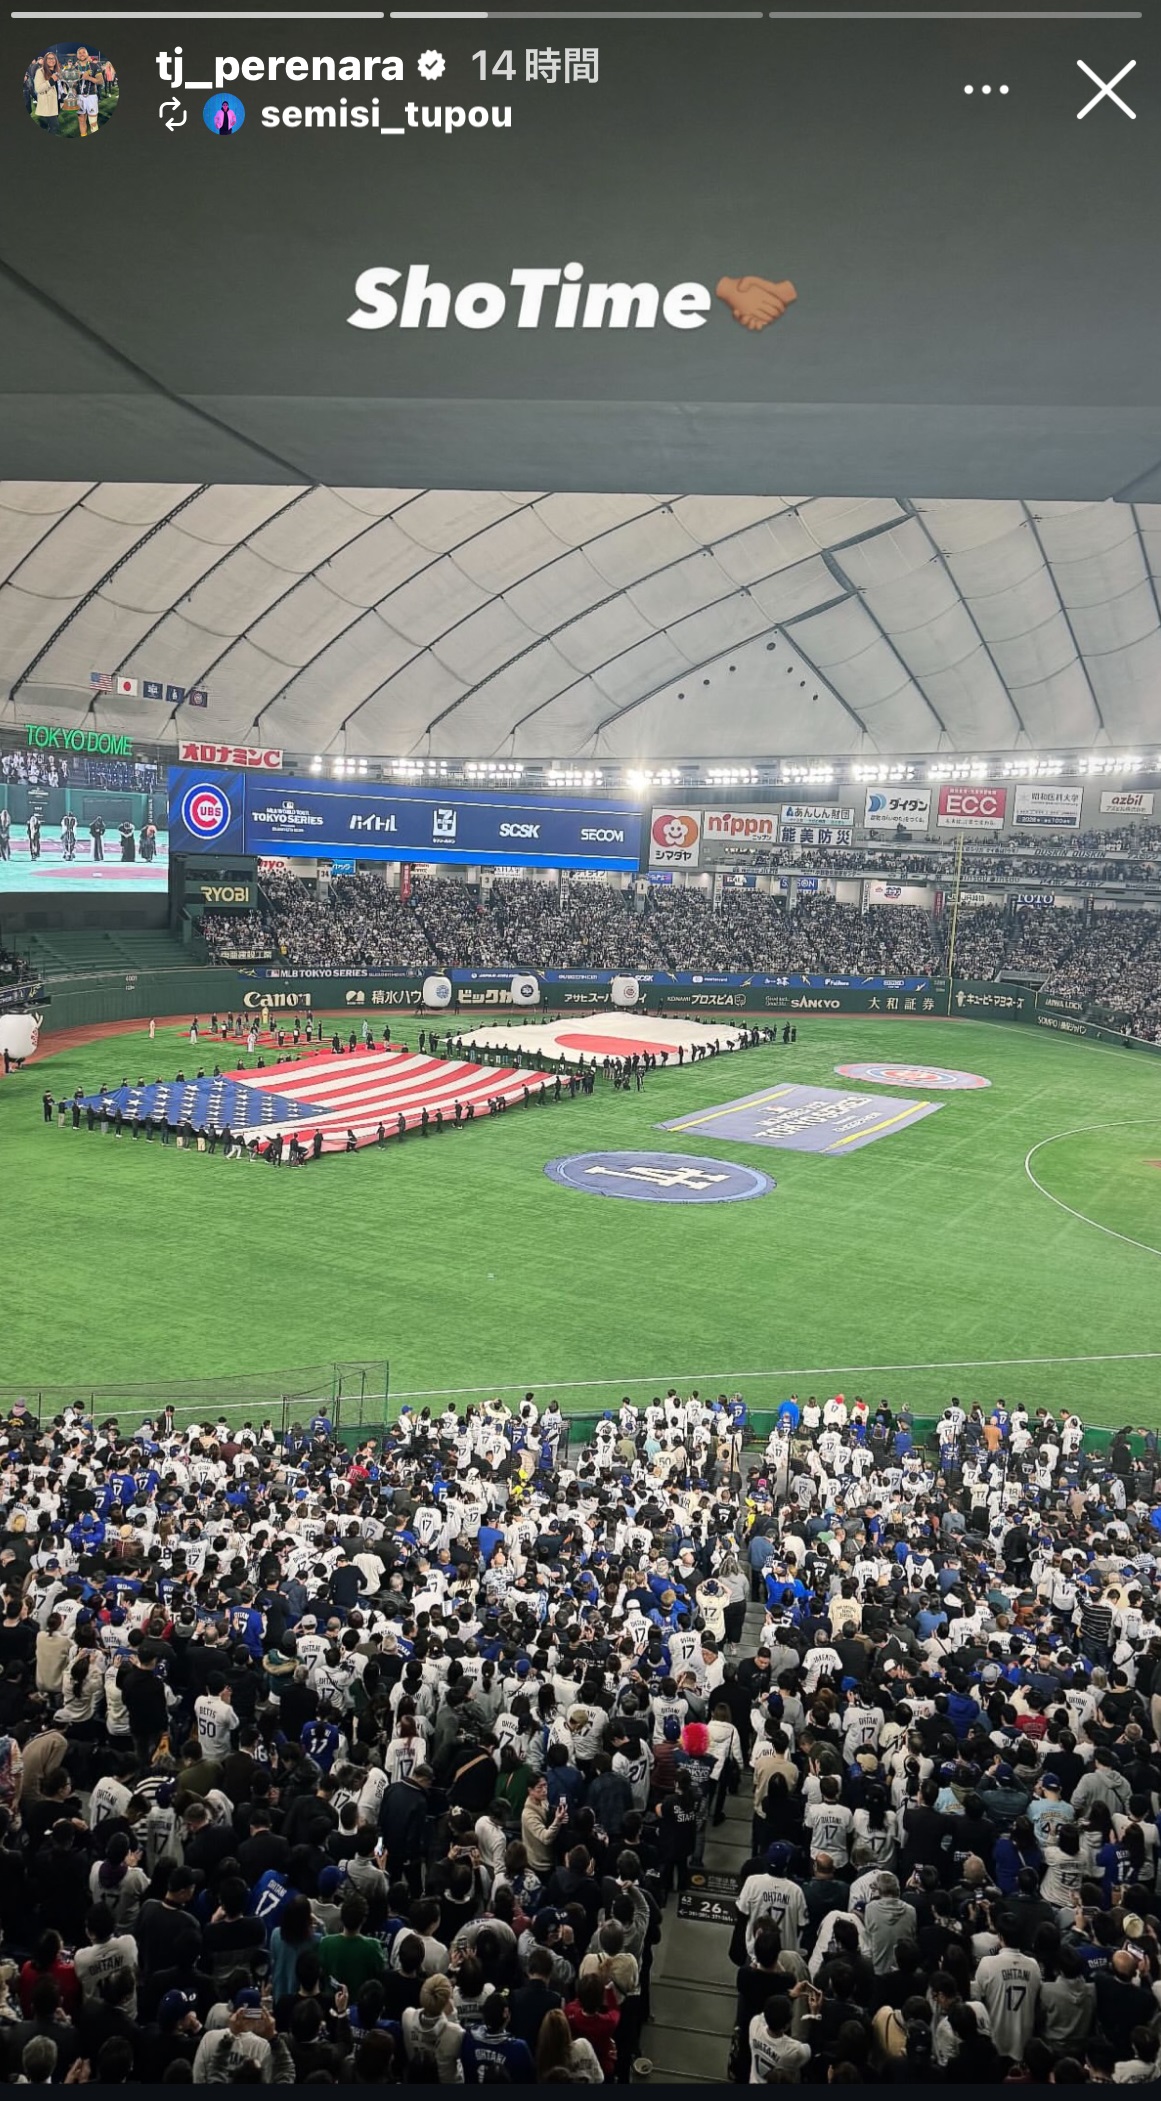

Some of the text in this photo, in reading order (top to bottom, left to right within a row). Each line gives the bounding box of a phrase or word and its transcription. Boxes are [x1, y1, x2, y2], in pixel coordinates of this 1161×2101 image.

[26, 724, 133, 756] TOKYO DOME
[182, 743, 281, 768] オロナミンC
[946, 795, 997, 815] ECC
[1111, 794, 1143, 806] azbil
[252, 812, 324, 825] TOKYO SERIES
[794, 807, 850, 820] あんしん財団
[350, 814, 397, 832] バイトル
[708, 814, 773, 836] nippn
[499, 823, 541, 839] SCSK
[580, 828, 625, 843] SECOM
[782, 827, 850, 844] 能美防災
[655, 850, 692, 861] シマダヤ
[201, 886, 249, 902] RYOBI
[1018, 894, 1054, 904] TOTO
[280, 970, 298, 978] MLB
[334, 969, 368, 978] SERIES
[243, 991, 312, 1009] Canon
[372, 990, 424, 1005] 積水ハウ
[791, 995, 840, 1009] SANKYO
[868, 998, 934, 1011] 大和証券
[585, 1165, 731, 1190] LA
[422, 1519, 430, 1531] 17
[188, 1554, 200, 1565] 17
[34, 1594, 46, 1609] 17
[704, 1608, 716, 1616] 17
[634, 1629, 644, 1642] 17
[682, 1645, 694, 1658] 17
[304, 1654, 316, 1670] 17
[322, 1688, 335, 1698] 17
[199, 1718, 216, 1738] 50
[861, 1727, 874, 1742] 17
[312, 1738, 329, 1752] 17
[332, 1792, 350, 1807] 17
[821, 1816, 842, 1824] OHTANI
[825, 1826, 837, 1839] 17
[154, 1833, 168, 1855] 17
[268, 1879, 287, 1897] OHTANI
[255, 1890, 280, 1916] 17
[763, 1891, 790, 1905] OHTANI
[700, 1902, 722, 1914] 26
[89, 1957, 124, 1975] OHTANI
[1002, 1969, 1030, 1980] OHTANI
[1006, 1986, 1026, 2010] 17
